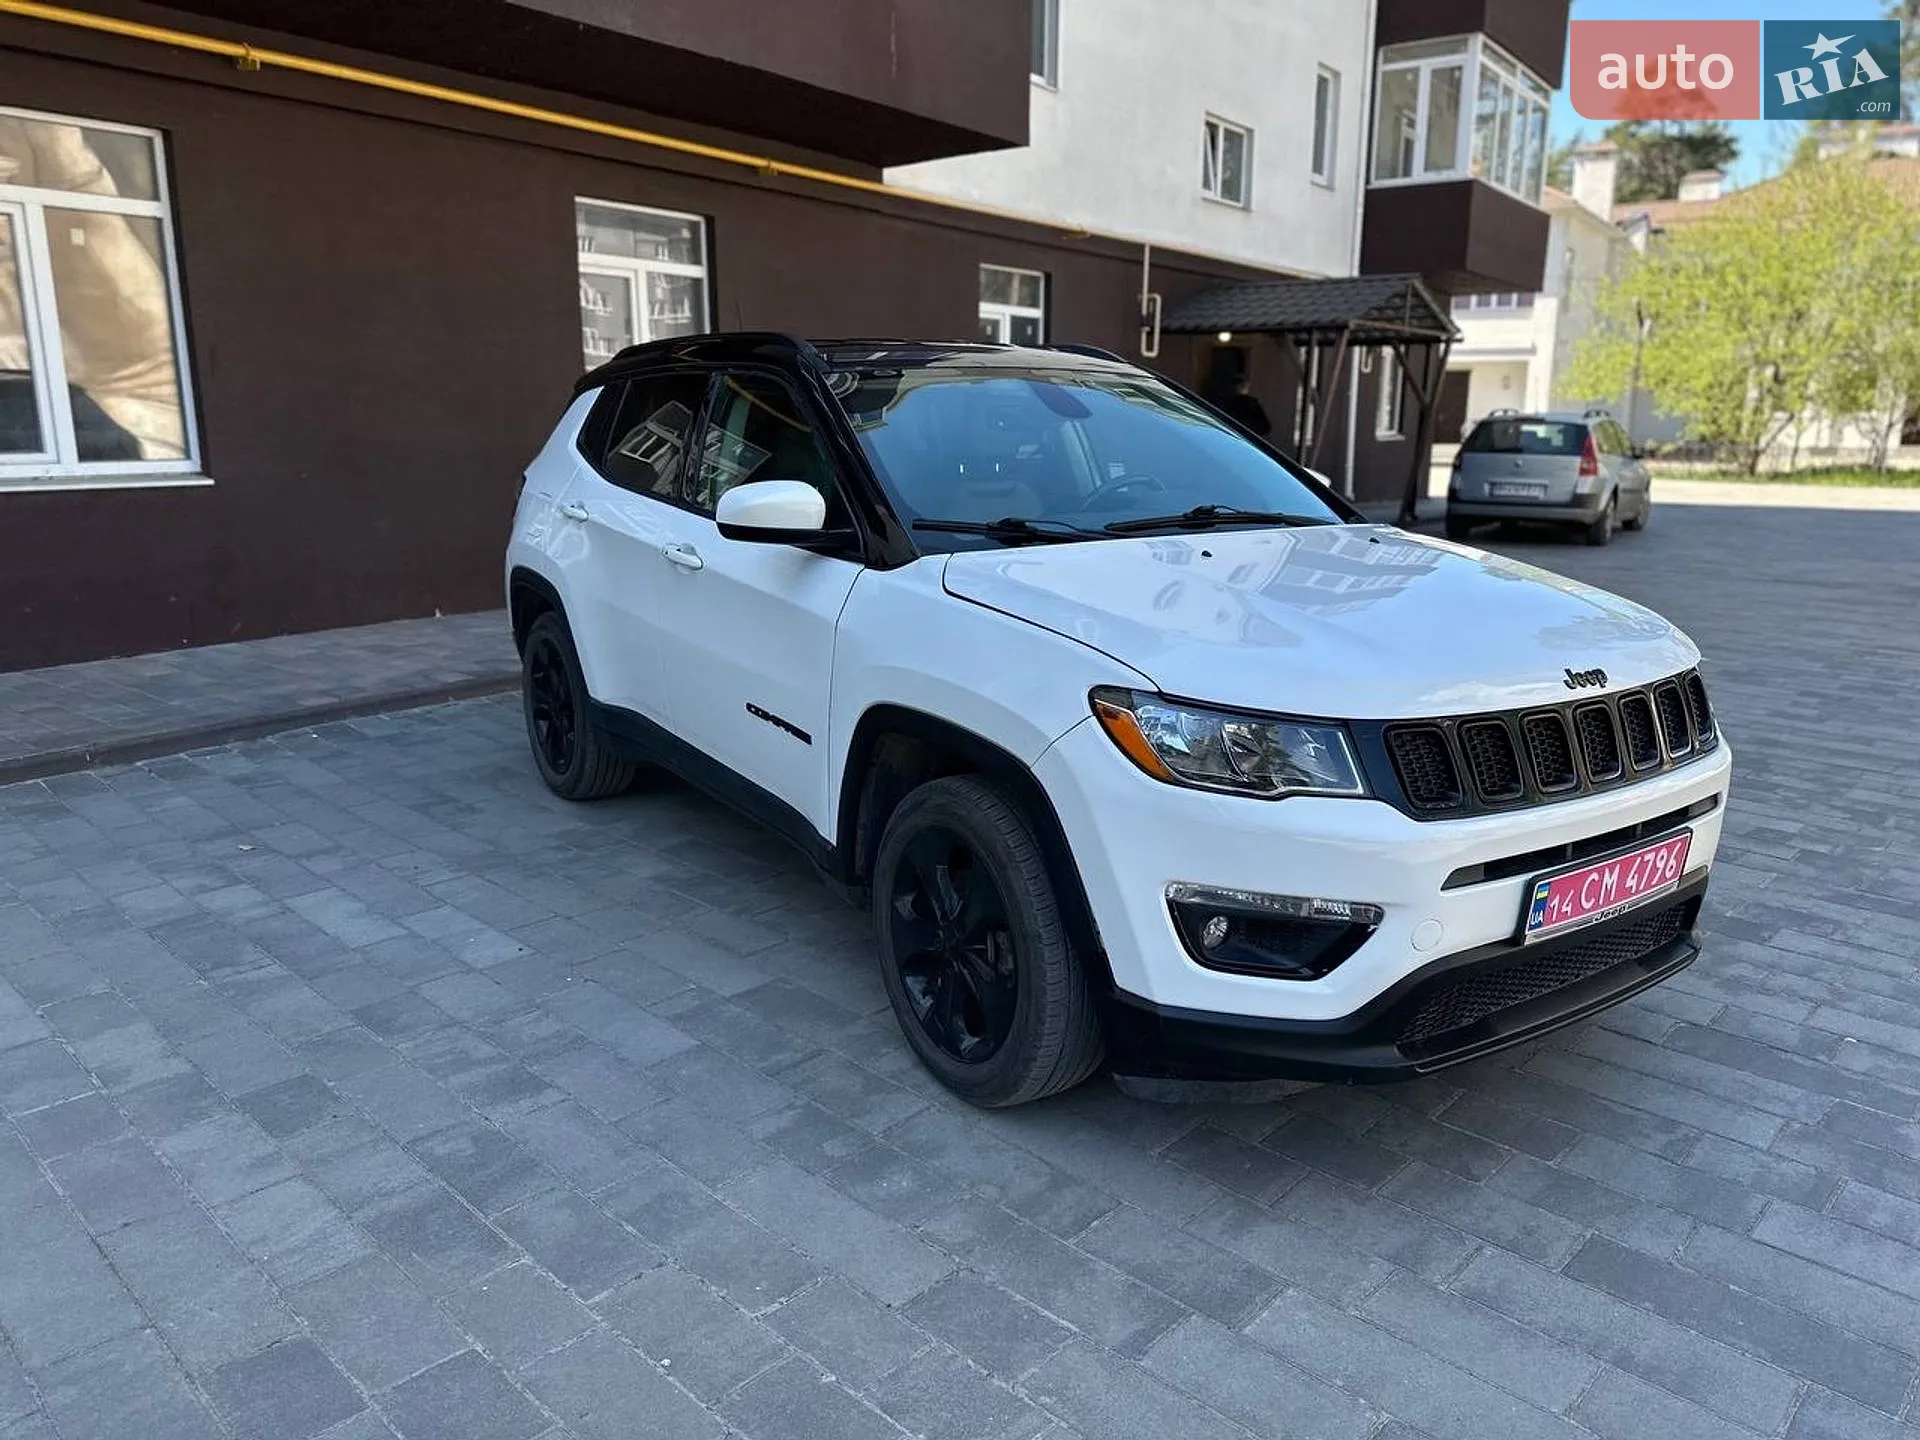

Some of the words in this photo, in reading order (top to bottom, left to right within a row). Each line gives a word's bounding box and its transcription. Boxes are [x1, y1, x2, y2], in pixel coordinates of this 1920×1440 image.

[1563, 668, 1608, 690] Jeep
[1550, 889, 1575, 922] 14
[1581, 864, 1621, 910] CM
[1625, 842, 1682, 894] 4796
[1529, 911, 1544, 926] UA
